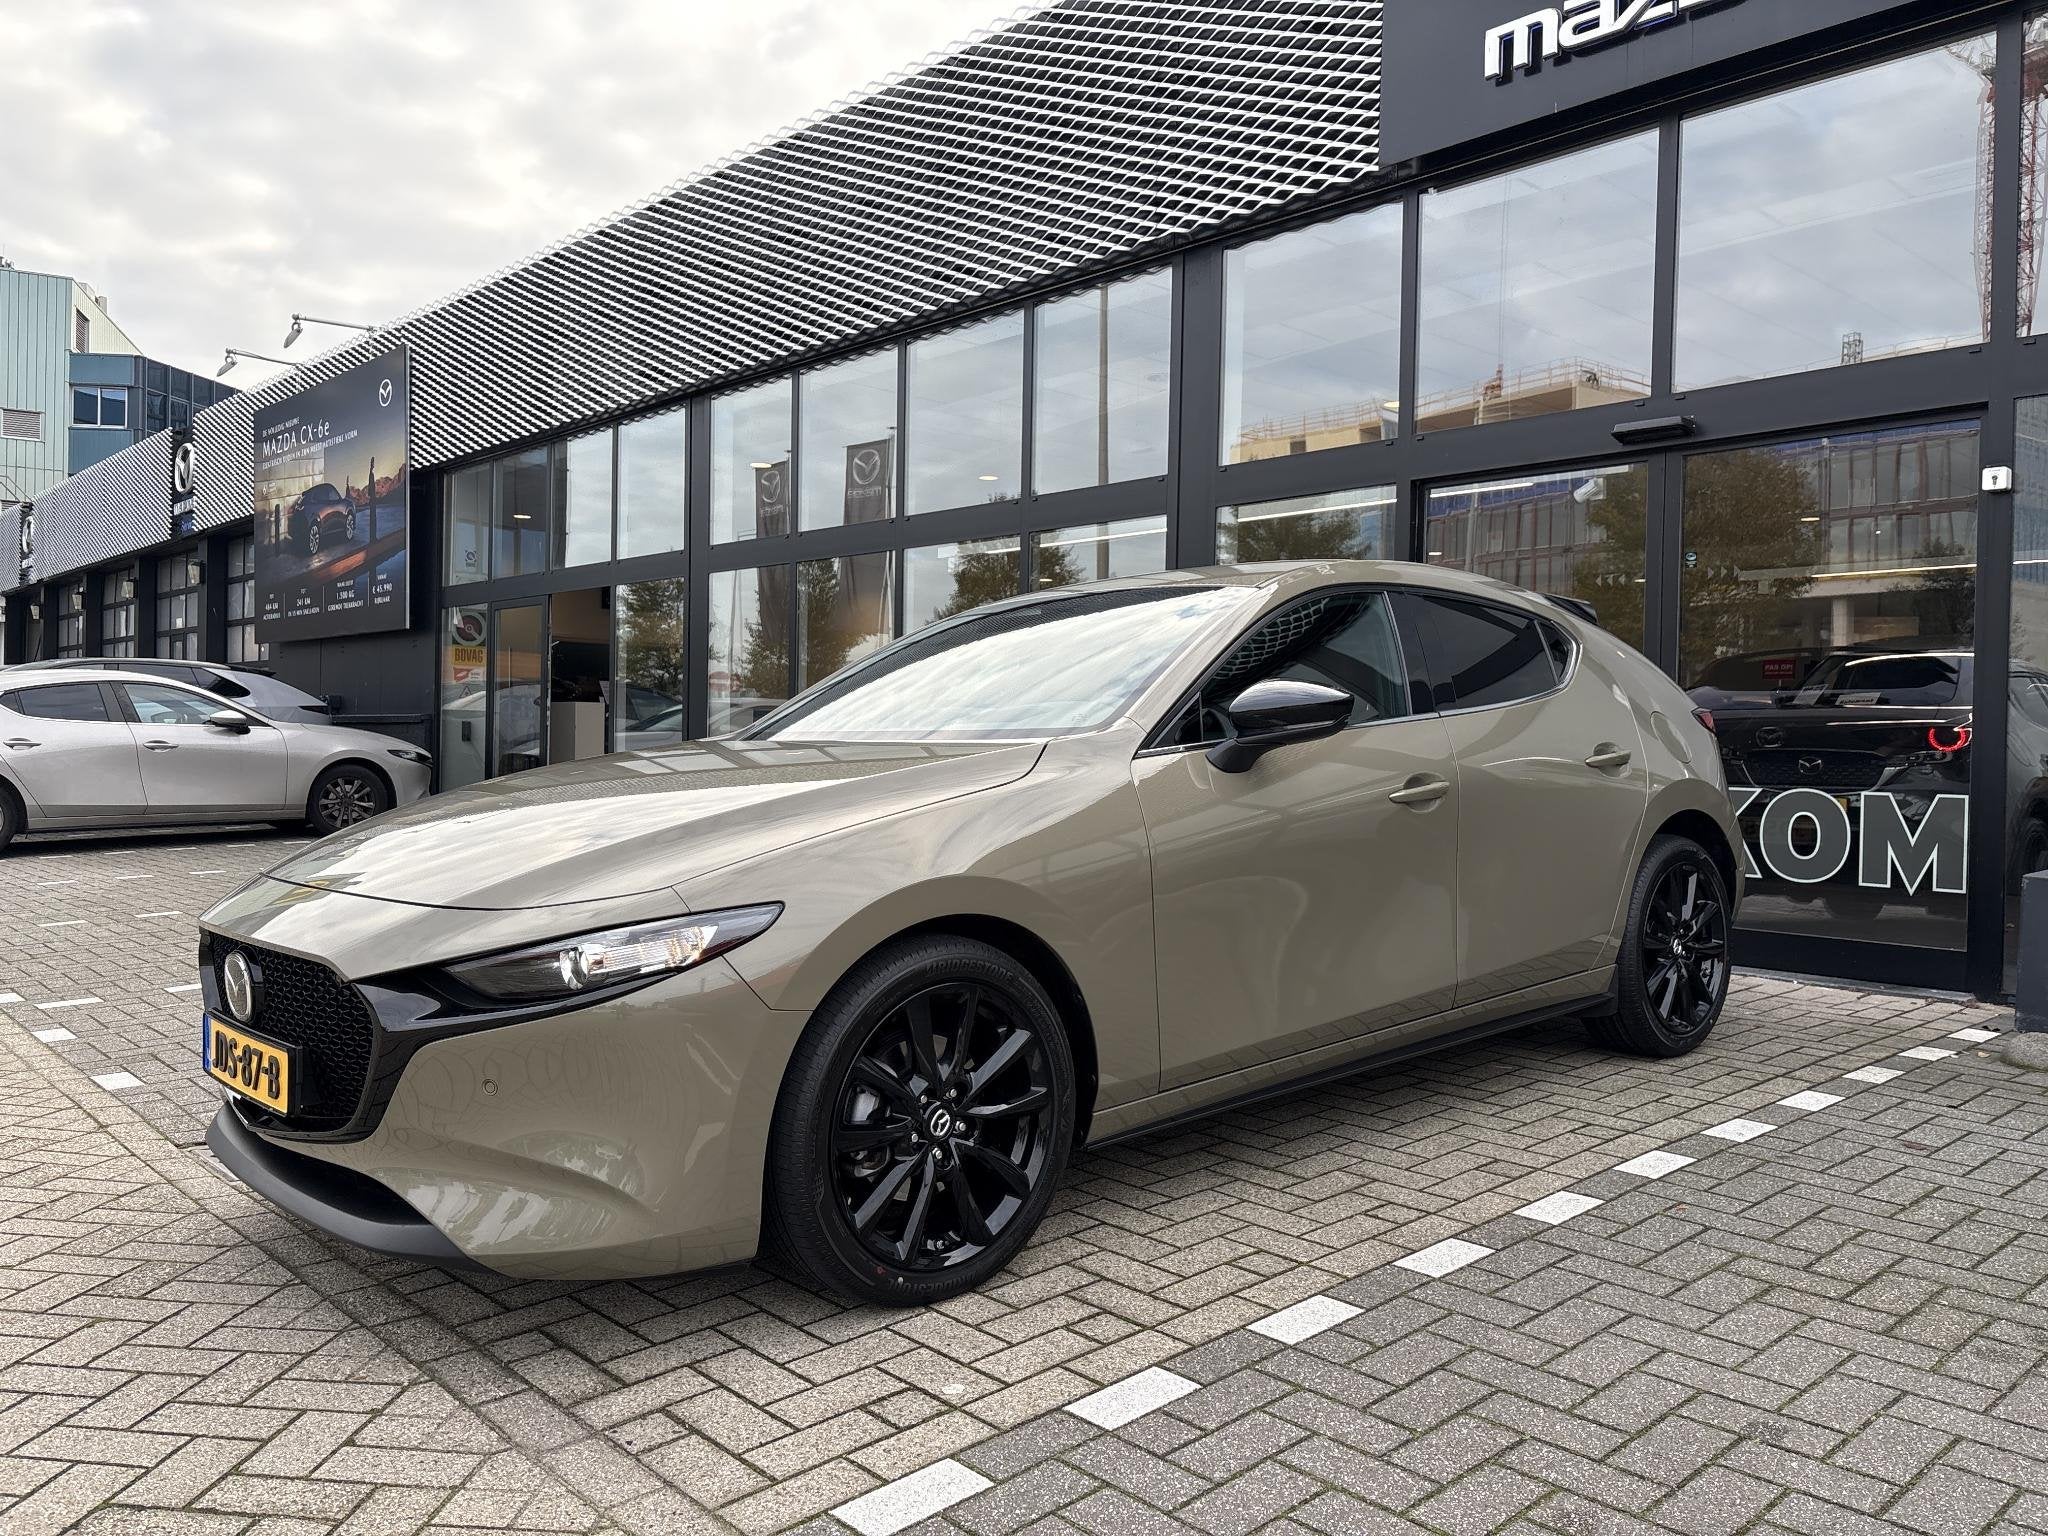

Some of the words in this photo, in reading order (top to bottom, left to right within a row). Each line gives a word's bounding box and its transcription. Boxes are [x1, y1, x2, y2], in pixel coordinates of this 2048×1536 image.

[262, 430, 297, 459] MAZDA
[300, 418, 330, 444] CX-6e
[455, 647, 484, 663] BOVAG
[212, 1030, 281, 1100] JDS-87-B
